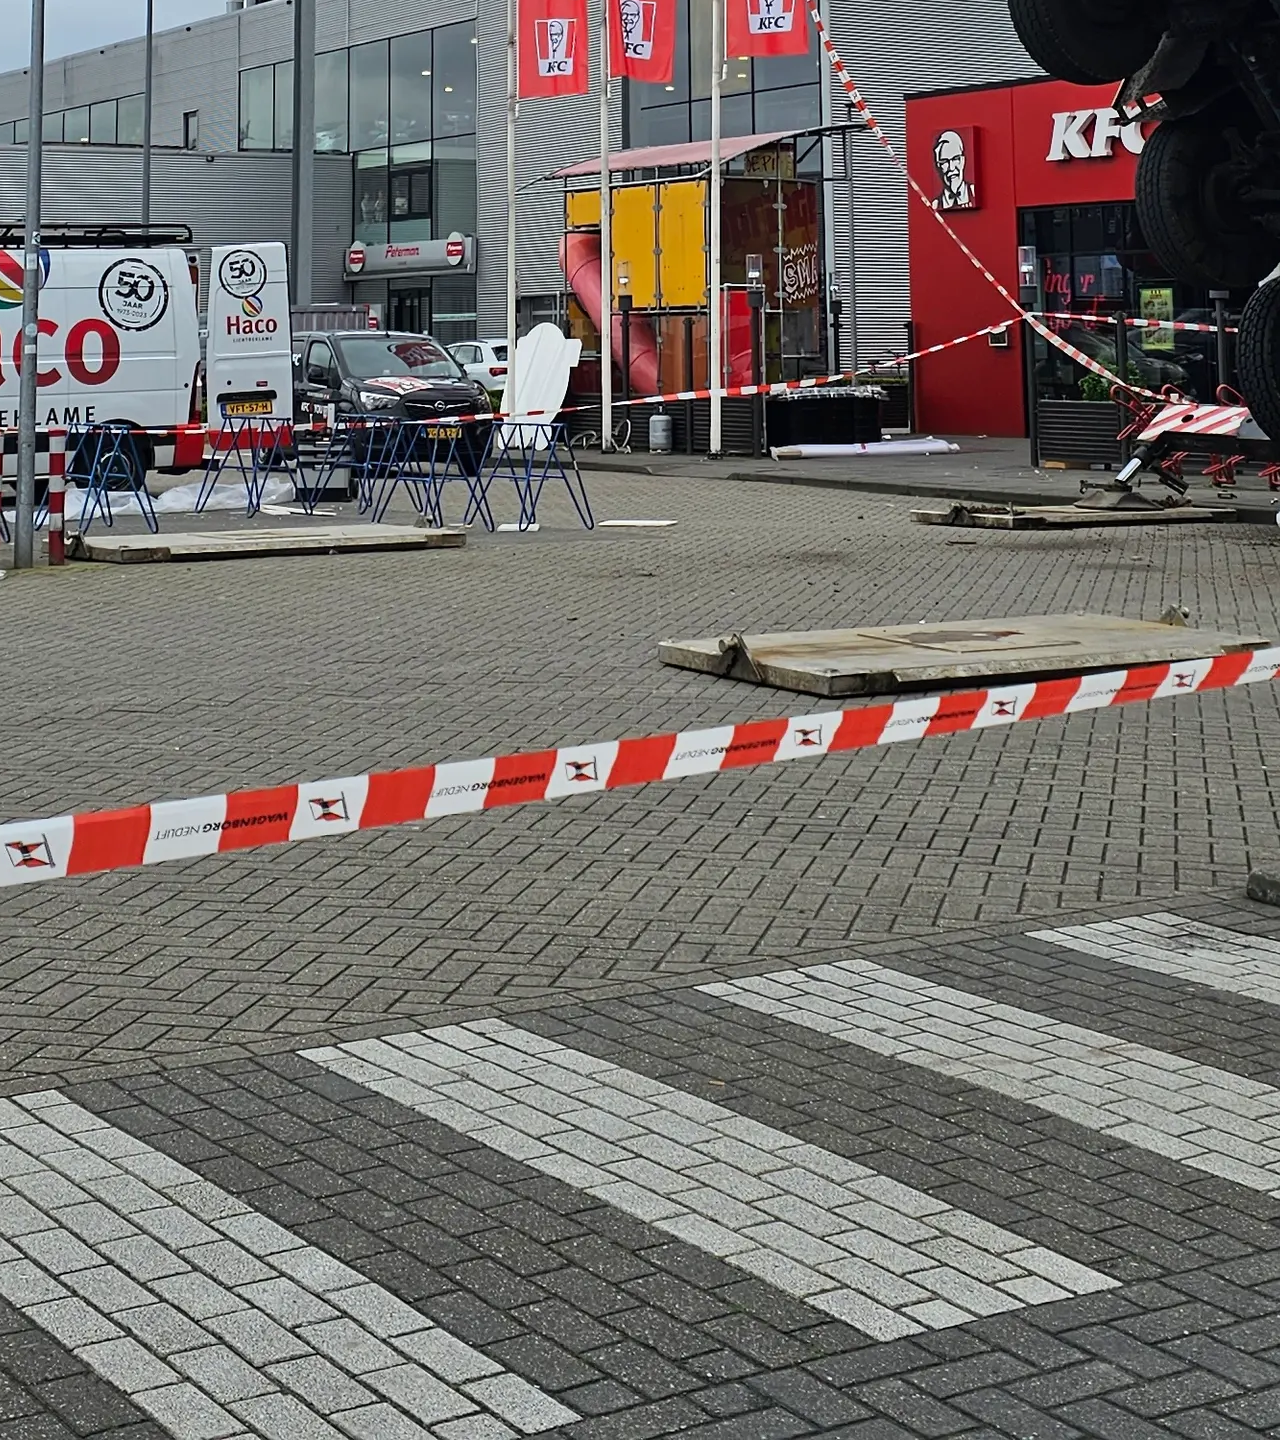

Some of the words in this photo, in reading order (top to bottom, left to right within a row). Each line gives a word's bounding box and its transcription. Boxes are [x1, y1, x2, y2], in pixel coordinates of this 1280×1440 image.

[757, 15, 786, 30] KFC
[625, 42, 645, 56] FC
[546, 59, 568, 74] KFC
[228, 257, 256, 280] 50
[114, 270, 155, 302] 50
[122, 300, 143, 309] JAAR
[226, 315, 278, 336] Haco
[468, 771, 546, 795] WAGENBORG
[201, 810, 289, 833] WAGENBORG
[153, 824, 201, 843] NEDLIFT
